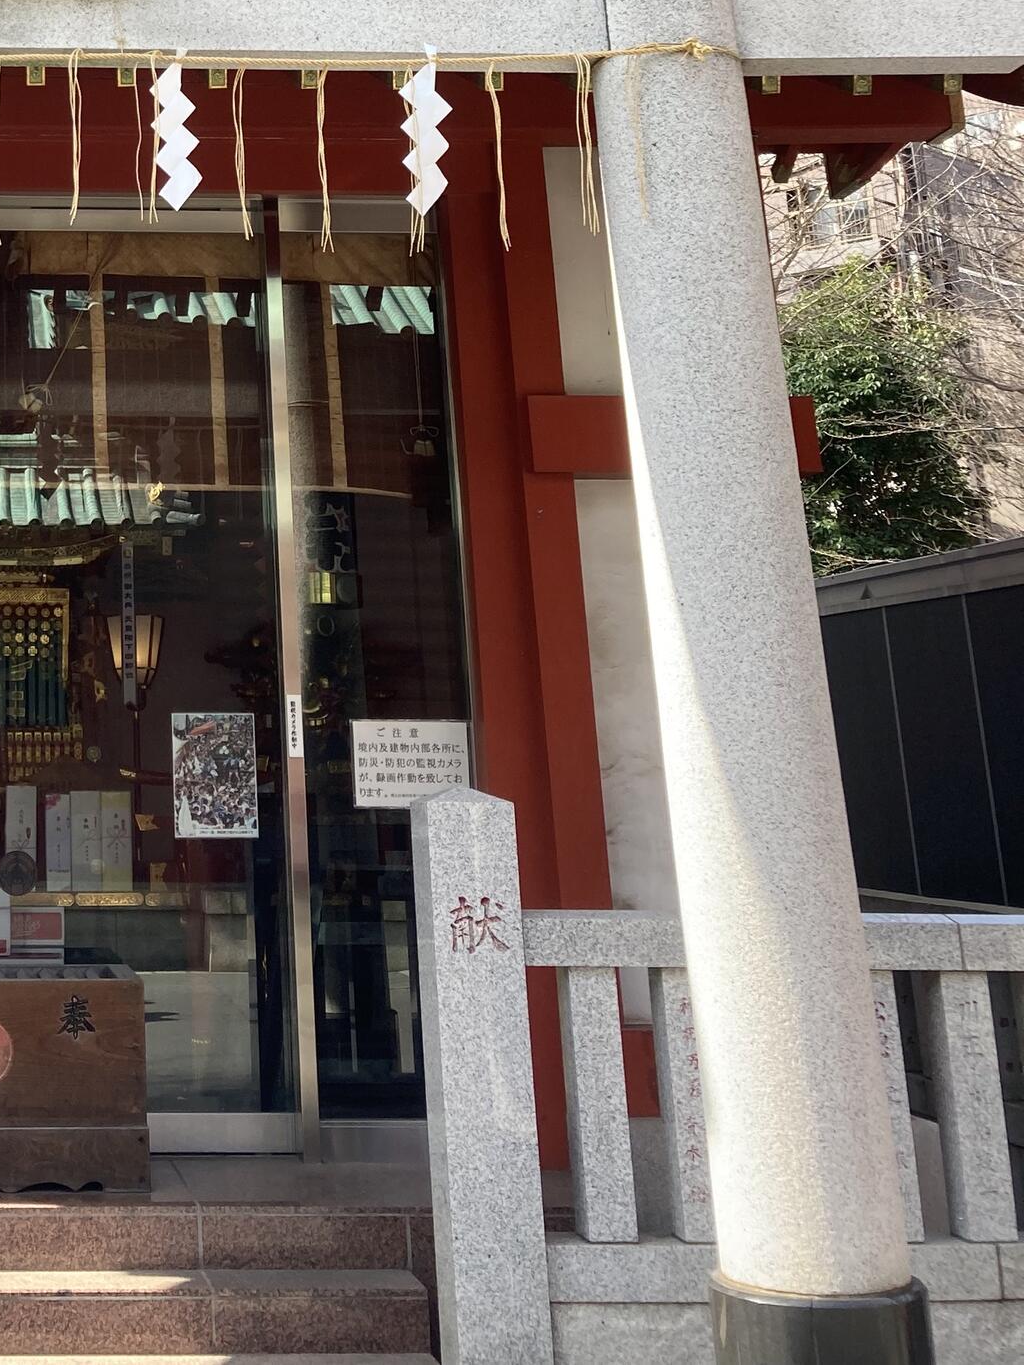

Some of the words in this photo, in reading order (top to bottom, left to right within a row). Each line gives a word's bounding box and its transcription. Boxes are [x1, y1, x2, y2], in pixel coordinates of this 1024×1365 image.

[377, 727, 419, 738] ご注意
[358, 743, 465, 754] 境内及建物内部各所に、
[358, 758, 462, 769] 防災・防犯の監視カメラ
[359, 772, 463, 784] が、録画作動を致してお
[359, 787, 388, 798] ります。
[449, 896, 511, 954] 献
[56, 995, 96, 1040] 奉
